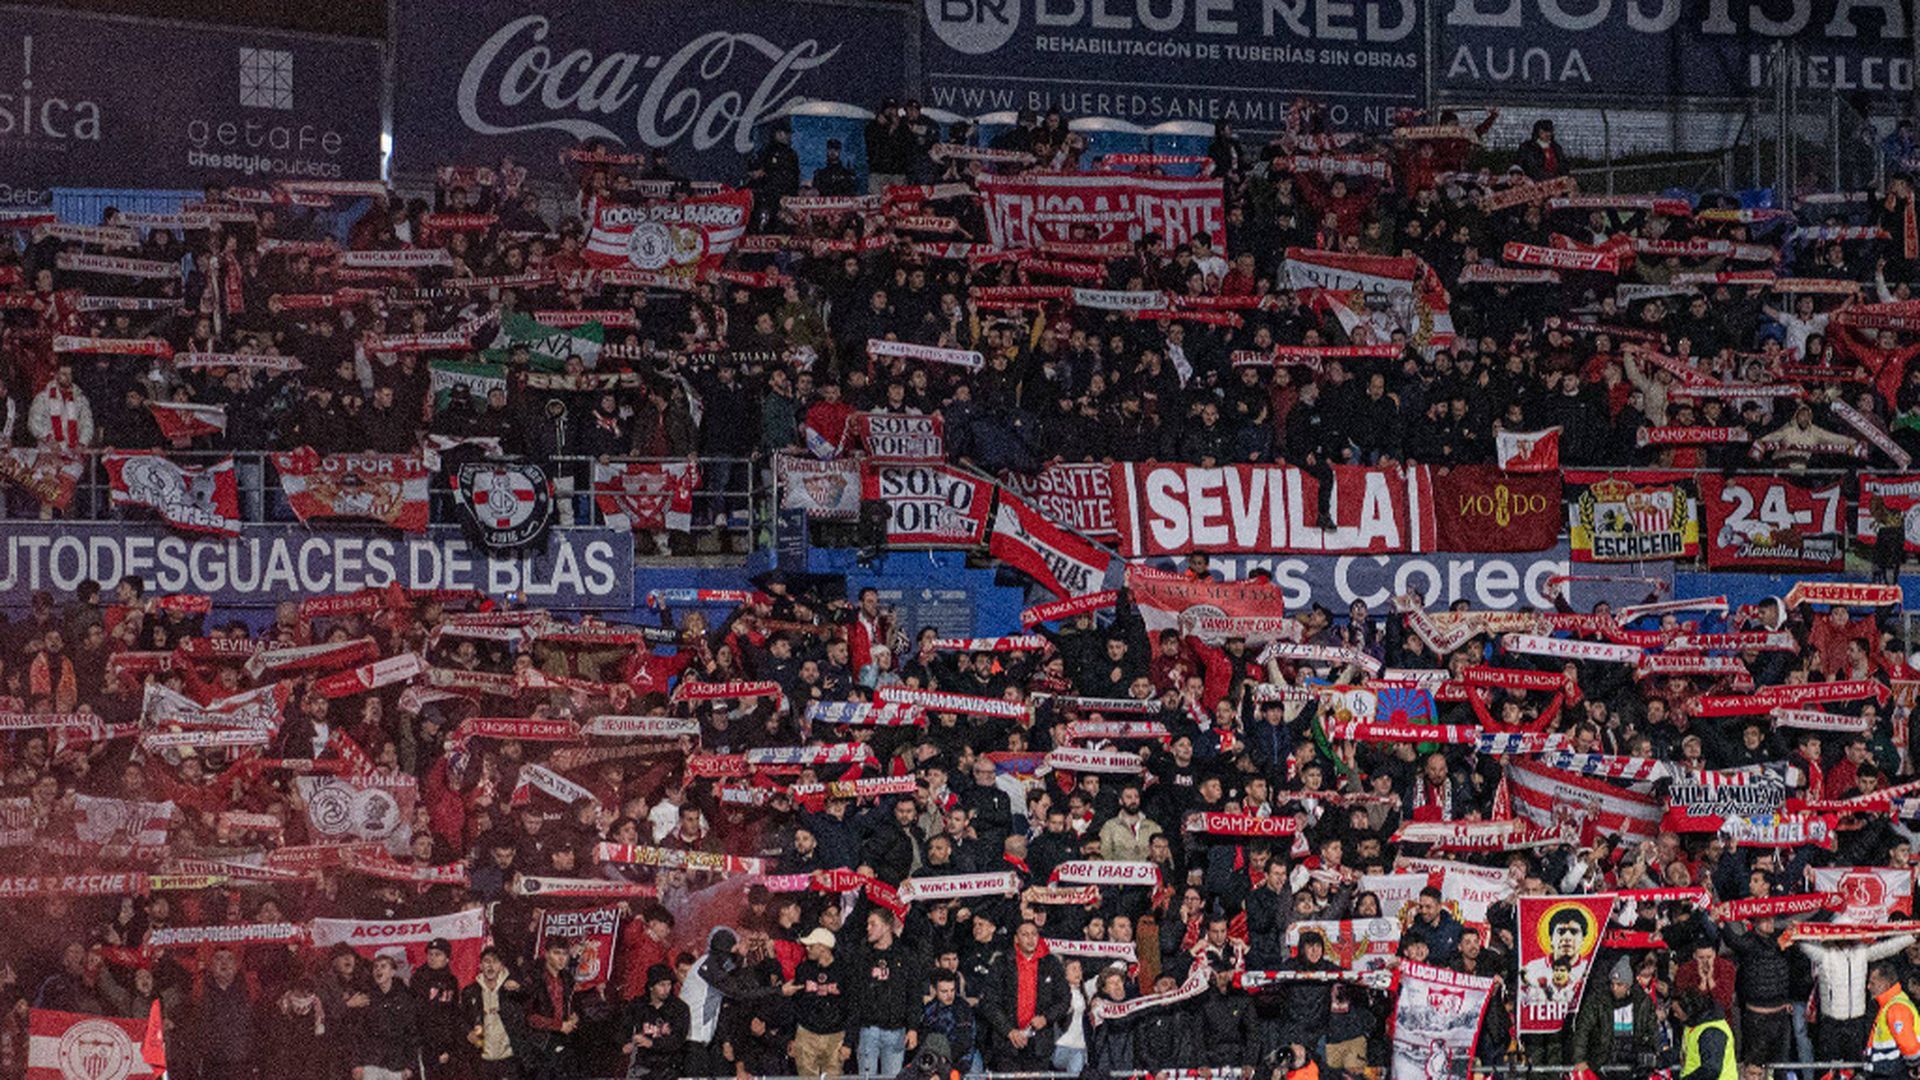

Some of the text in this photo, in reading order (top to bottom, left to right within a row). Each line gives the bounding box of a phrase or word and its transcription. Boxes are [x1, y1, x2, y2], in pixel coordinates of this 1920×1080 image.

[1035, 0, 1239, 34] BLUE
[1263, 0, 1417, 42] RED
[1036, 36, 1417, 69] REHABILITACIÓN DE TUBERÍAS SIN OBRAS
[457, 14, 844, 154] Coca-Col
[188, 119, 342, 154] getafe
[684, 205, 742, 227] BARRIO
[870, 417, 934, 434] SOLO
[346, 459, 394, 474] POR
[1146, 466, 1402, 550] SEVILLA
[1720, 485, 1841, 535] 24-7
[1593, 533, 1683, 557] ESCACENA
[409, 540, 473, 591] DE
[487, 540, 616, 596] BLAS
[1334, 556, 1571, 610] Corea
[212, 639, 264, 652] SEVILLA
[1469, 671, 1505, 682] NUNCA
[1507, 673, 1520, 684] TE
[1369, 726, 1418, 737] SEVILLA
[1051, 752, 1089, 764] NUNCA
[1091, 756, 1107, 766] ME
[1670, 784, 1784, 807] VILLANUEVA
[546, 907, 617, 925] NERVIÓN
[351, 923, 432, 938] ACOSTA
